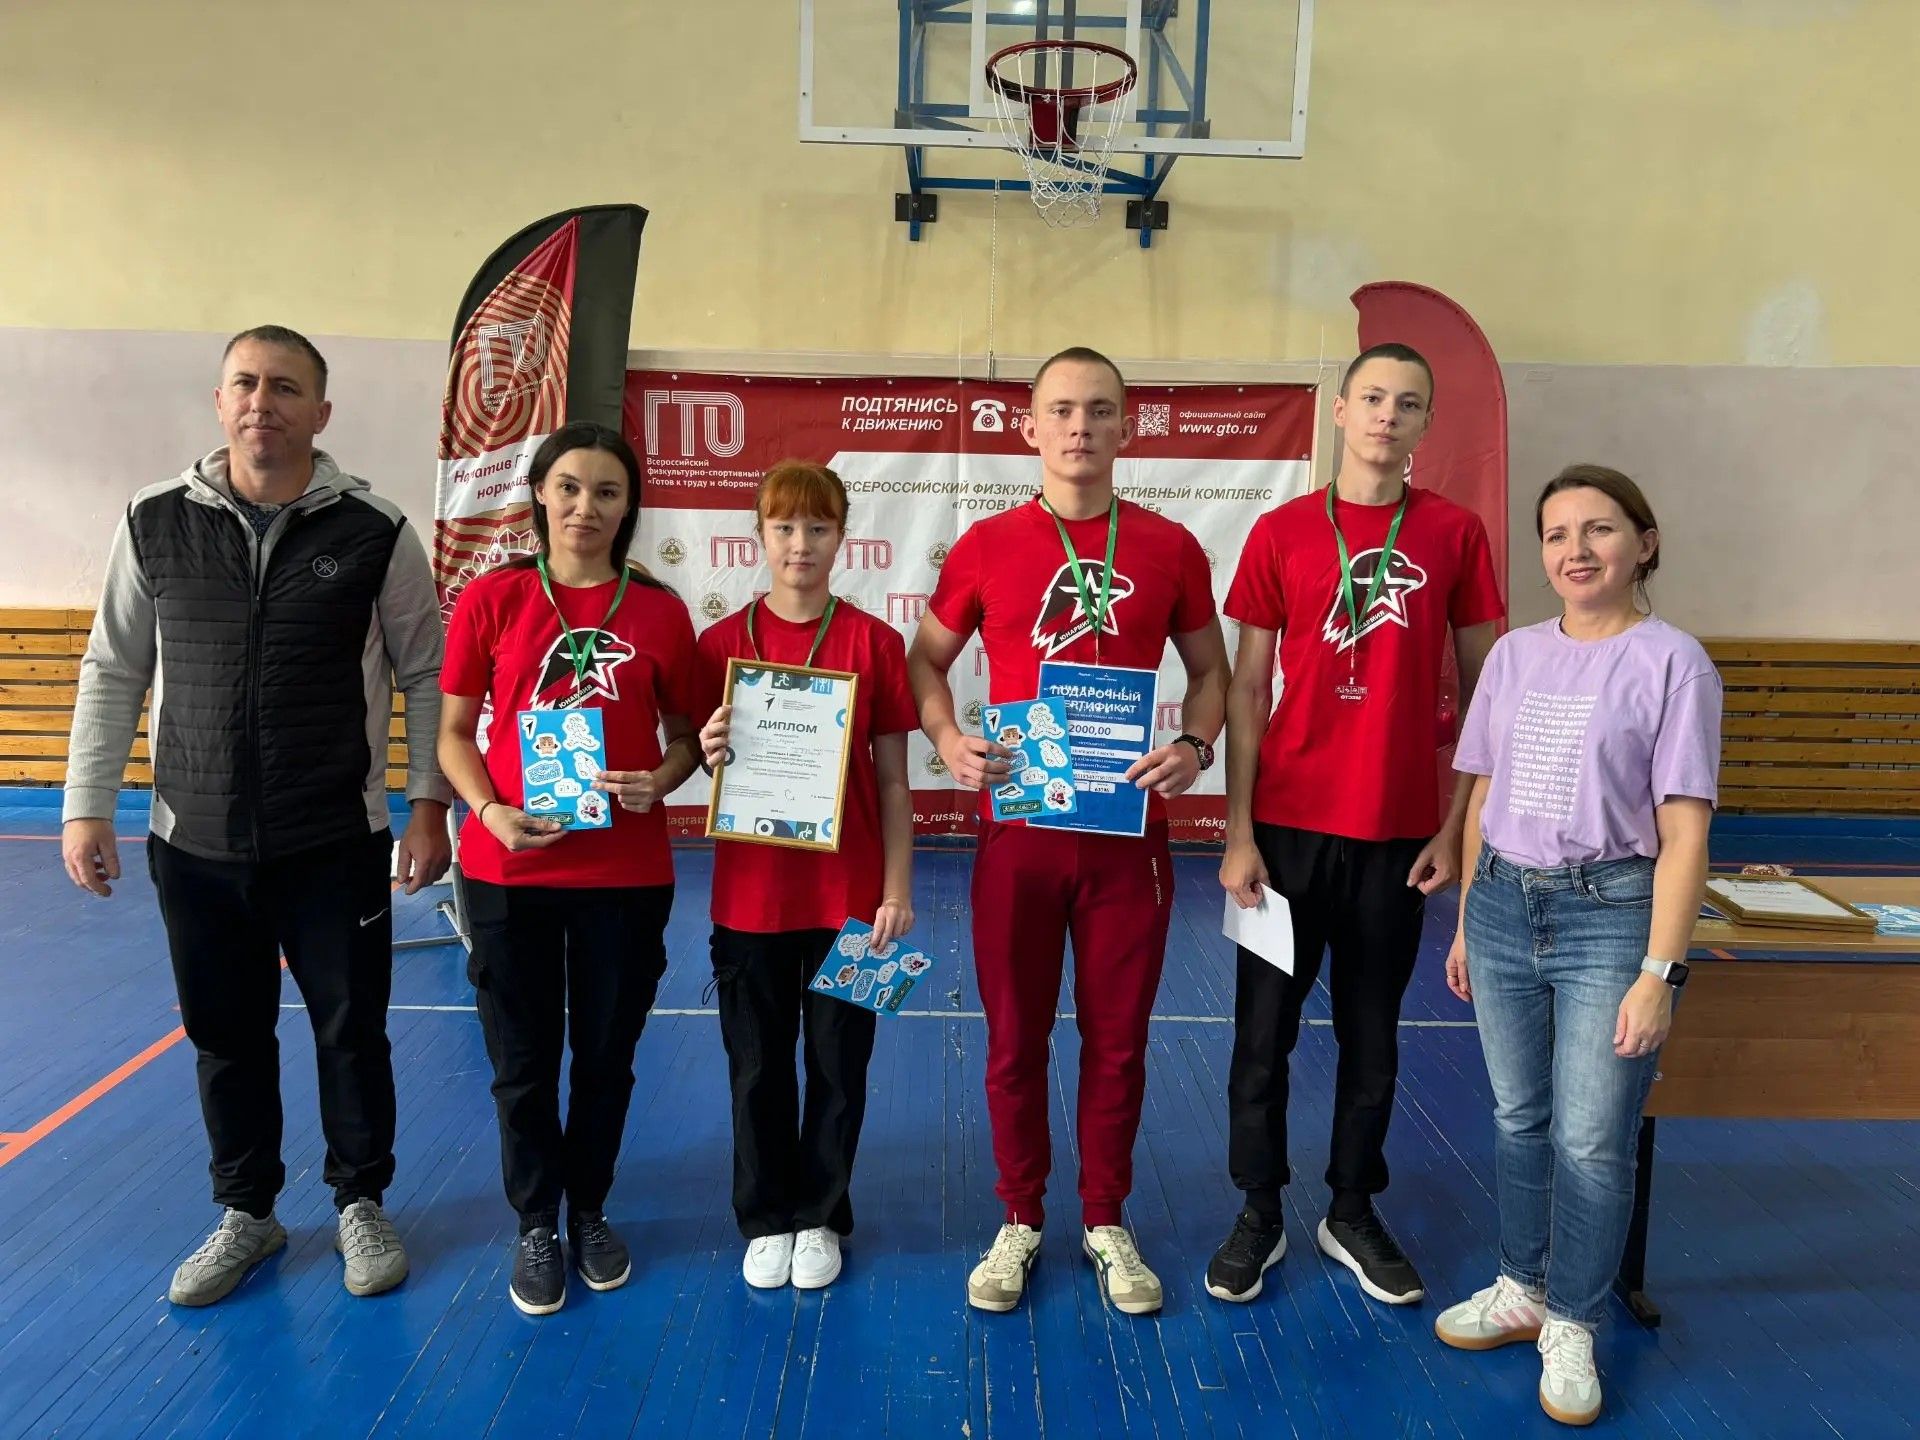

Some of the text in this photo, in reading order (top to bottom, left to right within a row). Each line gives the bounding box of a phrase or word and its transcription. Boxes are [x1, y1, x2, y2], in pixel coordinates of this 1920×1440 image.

[841, 396, 958, 415] ПОДТЯНИСЬ
[1179, 410, 1266, 420] официальный сайт
[644, 389, 745, 458] ГТО
[841, 418, 943, 432] К ДВИЖЕНИЮ
[1179, 422, 1258, 437] www.gto.ru
[646, 457, 709, 467] Всероссийский
[647, 467, 760, 478] физкультурно-спортивный
[648, 478, 674, 486] «Готов
[683, 480, 707, 488] труду
[718, 480, 759, 488] обороне»
[844, 480, 969, 494] ВСЕРОССИЙСКИЙ
[1195, 488, 1273, 500] КОМПЛЕКС
[952, 499, 1007, 510] «ГОТОВ
[710, 536, 759, 568] ГТО
[846, 538, 893, 570] ГТО
[1051, 685, 1142, 702] ПОДАРОЧНЫЙ
[1064, 699, 1137, 714] ЕРТИФИКАТ
[757, 719, 818, 734] ДИПЛОМ
[1069, 724, 1112, 736] 2000,00
